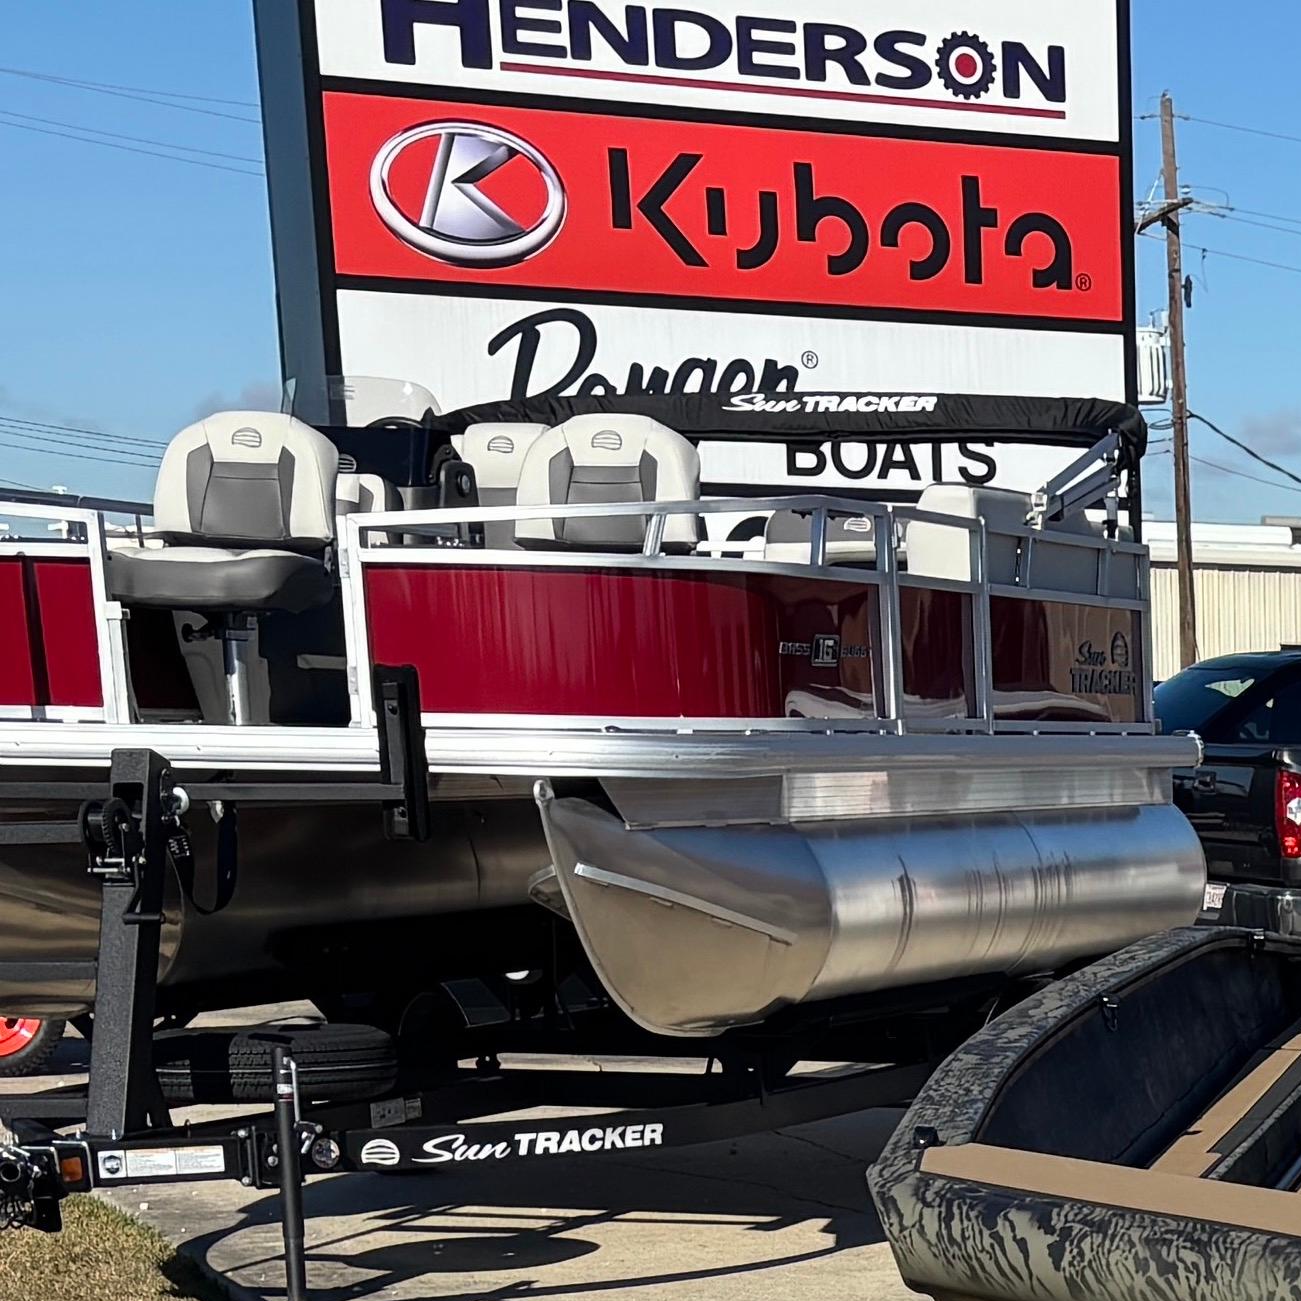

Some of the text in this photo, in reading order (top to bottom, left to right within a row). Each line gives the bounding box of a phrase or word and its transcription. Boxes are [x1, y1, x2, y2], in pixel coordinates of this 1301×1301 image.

[381, 0, 1066, 103] HENDERSON
[722, 393, 938, 413] Sun TRACKER
[411, 1123, 664, 1163] Sun TRACKER
